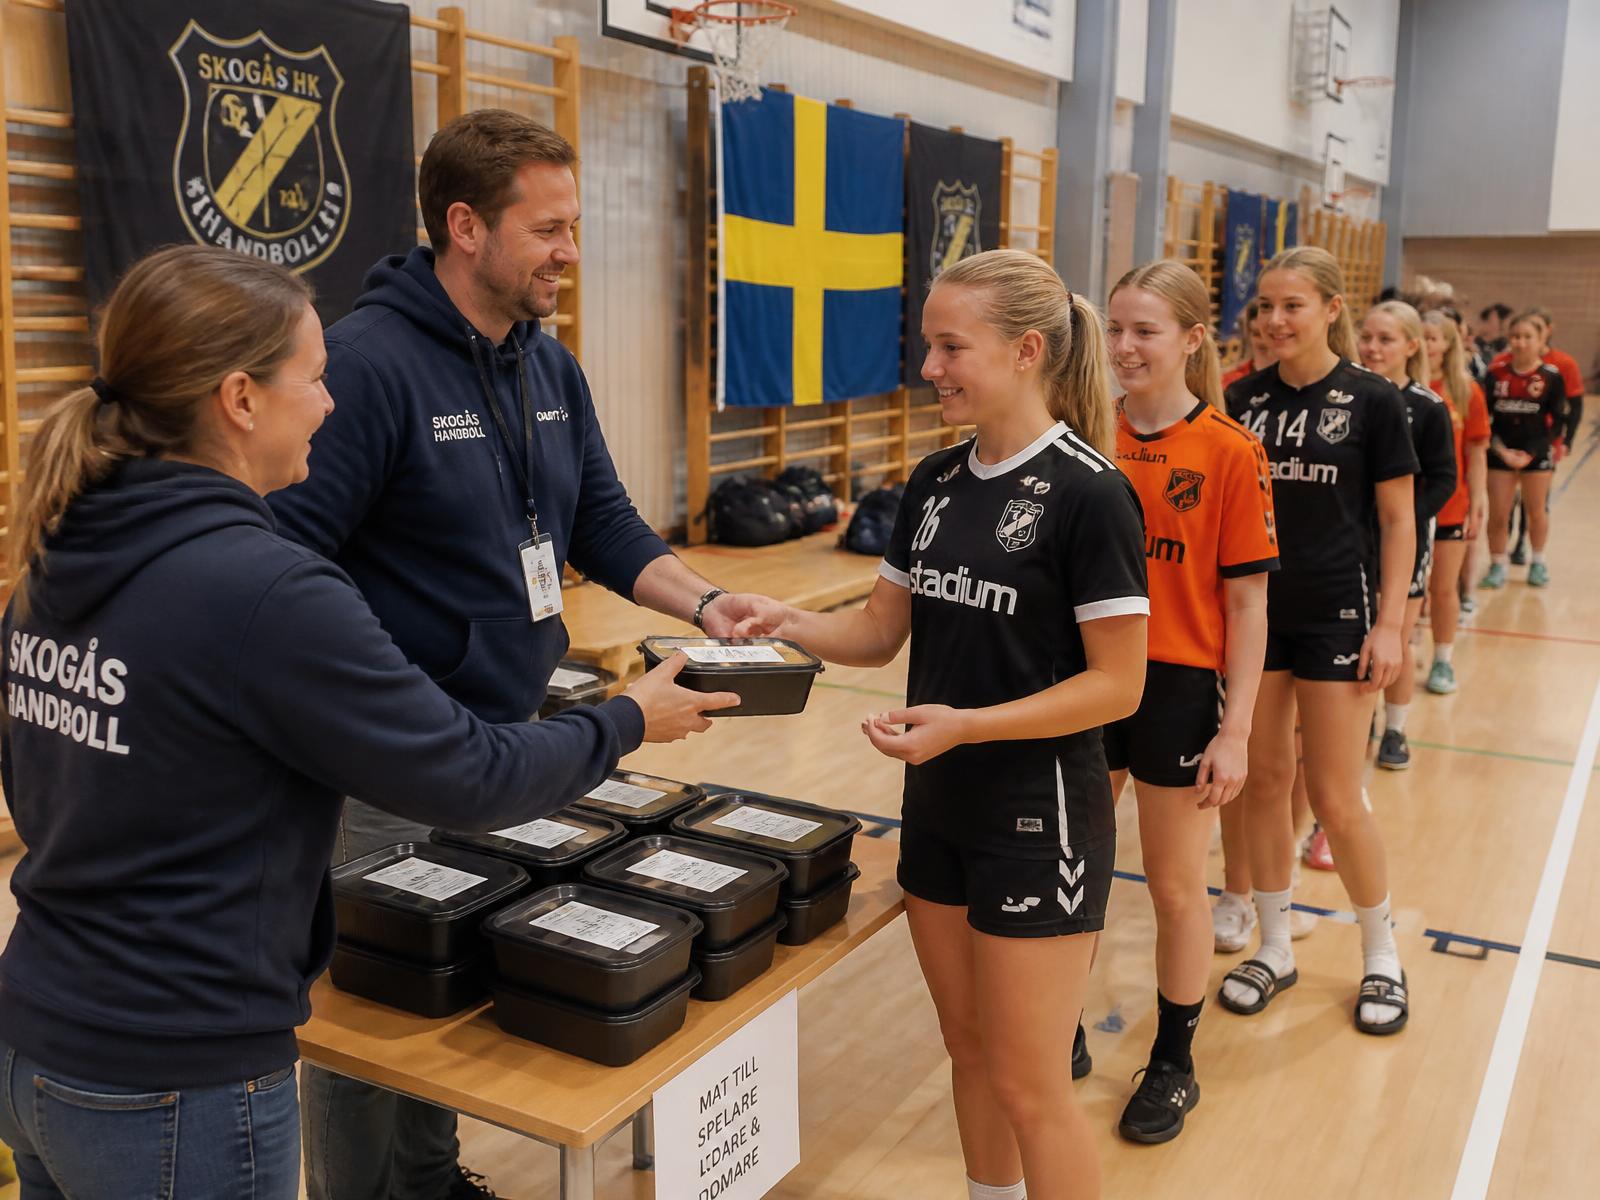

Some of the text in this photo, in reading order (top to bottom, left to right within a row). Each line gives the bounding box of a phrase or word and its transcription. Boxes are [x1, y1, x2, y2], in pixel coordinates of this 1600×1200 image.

[198, 53, 322, 99] SKOGÅS HK
[432, 409, 480, 429] SKOGÅS
[434, 427, 486, 442] HANDBOLL
[1275, 409, 1308, 447] 14
[1268, 457, 1338, 485] adium
[910, 560, 1018, 616] stadium
[9, 630, 128, 706] SKOGÅS
[8, 682, 130, 755] HANDBOLL
[699, 1056, 759, 1114] MAT TILL
[698, 1085, 758, 1148] SPELARE
[750, 1116, 761, 1137] &
[698, 1146, 759, 1200] DOMARE
